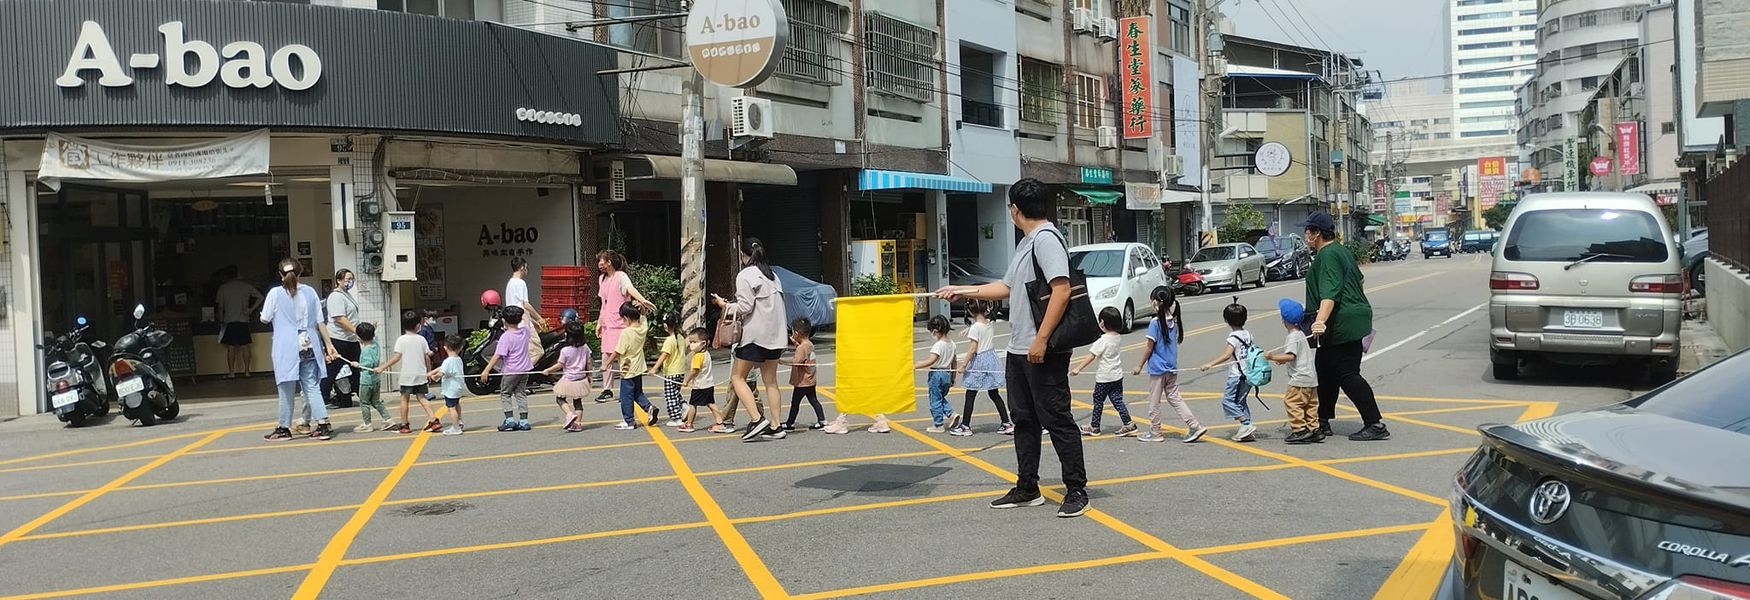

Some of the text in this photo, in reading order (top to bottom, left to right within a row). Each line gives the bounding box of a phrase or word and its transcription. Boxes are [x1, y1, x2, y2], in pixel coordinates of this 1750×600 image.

[701, 13, 761, 34] A-bao
[56, 20, 321, 91] A-bao
[396, 221, 406, 229] 95
[477, 222, 539, 246] A-bao
[1657, 540, 1729, 563] COROLLA
